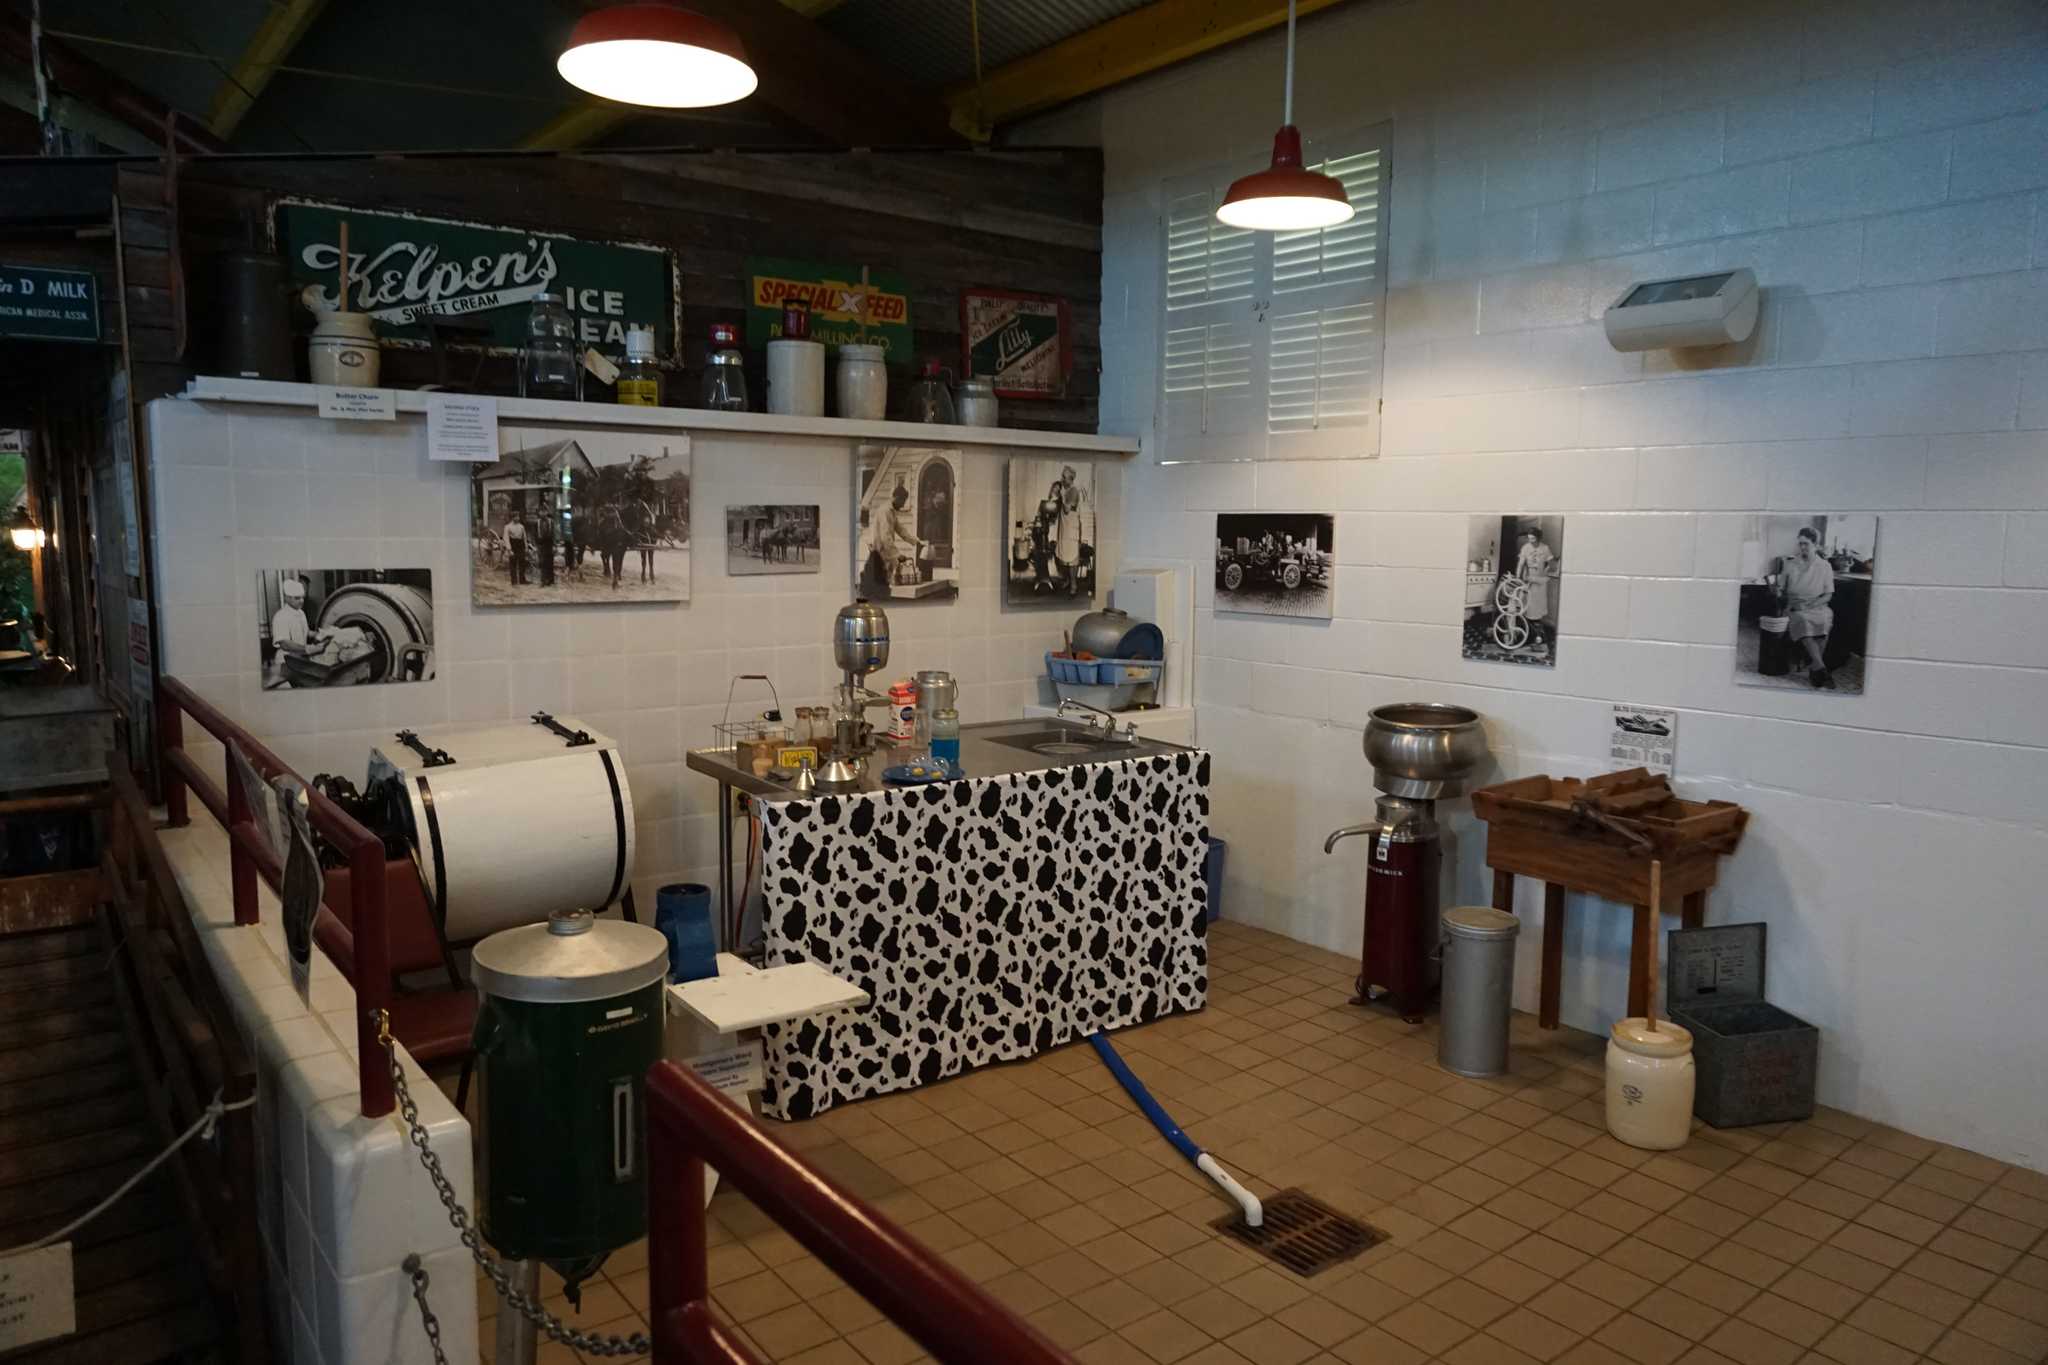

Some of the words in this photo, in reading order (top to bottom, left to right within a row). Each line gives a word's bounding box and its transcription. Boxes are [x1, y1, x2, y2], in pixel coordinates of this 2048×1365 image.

[20, 279, 34, 295] D
[48, 280, 88, 299] MILK
[302, 239, 558, 311] Kelpen's
[402, 302, 448, 322] SWEET
[452, 294, 500, 314] CREAM
[566, 286, 625, 317] ICE
[759, 280, 838, 312] SPECIAL
[866, 295, 905, 320] FEED
